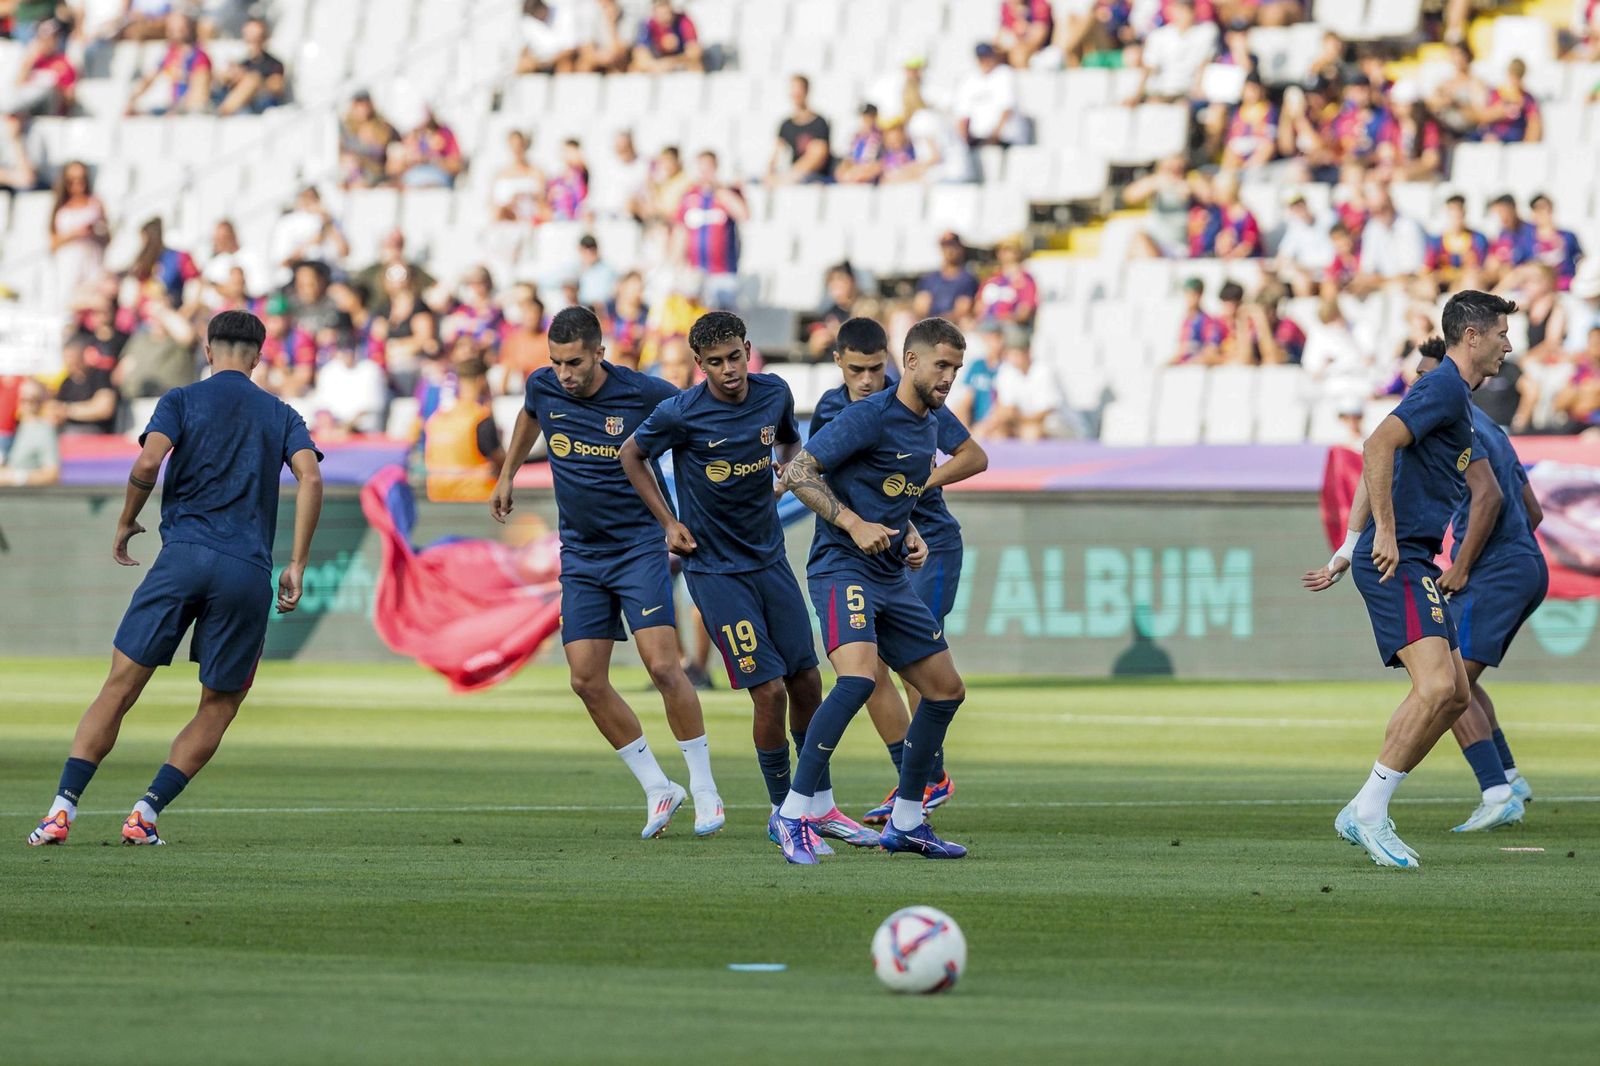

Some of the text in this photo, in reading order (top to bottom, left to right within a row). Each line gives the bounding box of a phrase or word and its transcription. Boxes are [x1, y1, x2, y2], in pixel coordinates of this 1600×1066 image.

[574, 441, 621, 460] Spotify
[733, 456, 770, 477] Spotif
[846, 585, 865, 612] 5
[985, 546, 1254, 638] ALBUM
[1421, 576, 1440, 604] 9
[721, 619, 758, 656] 19
